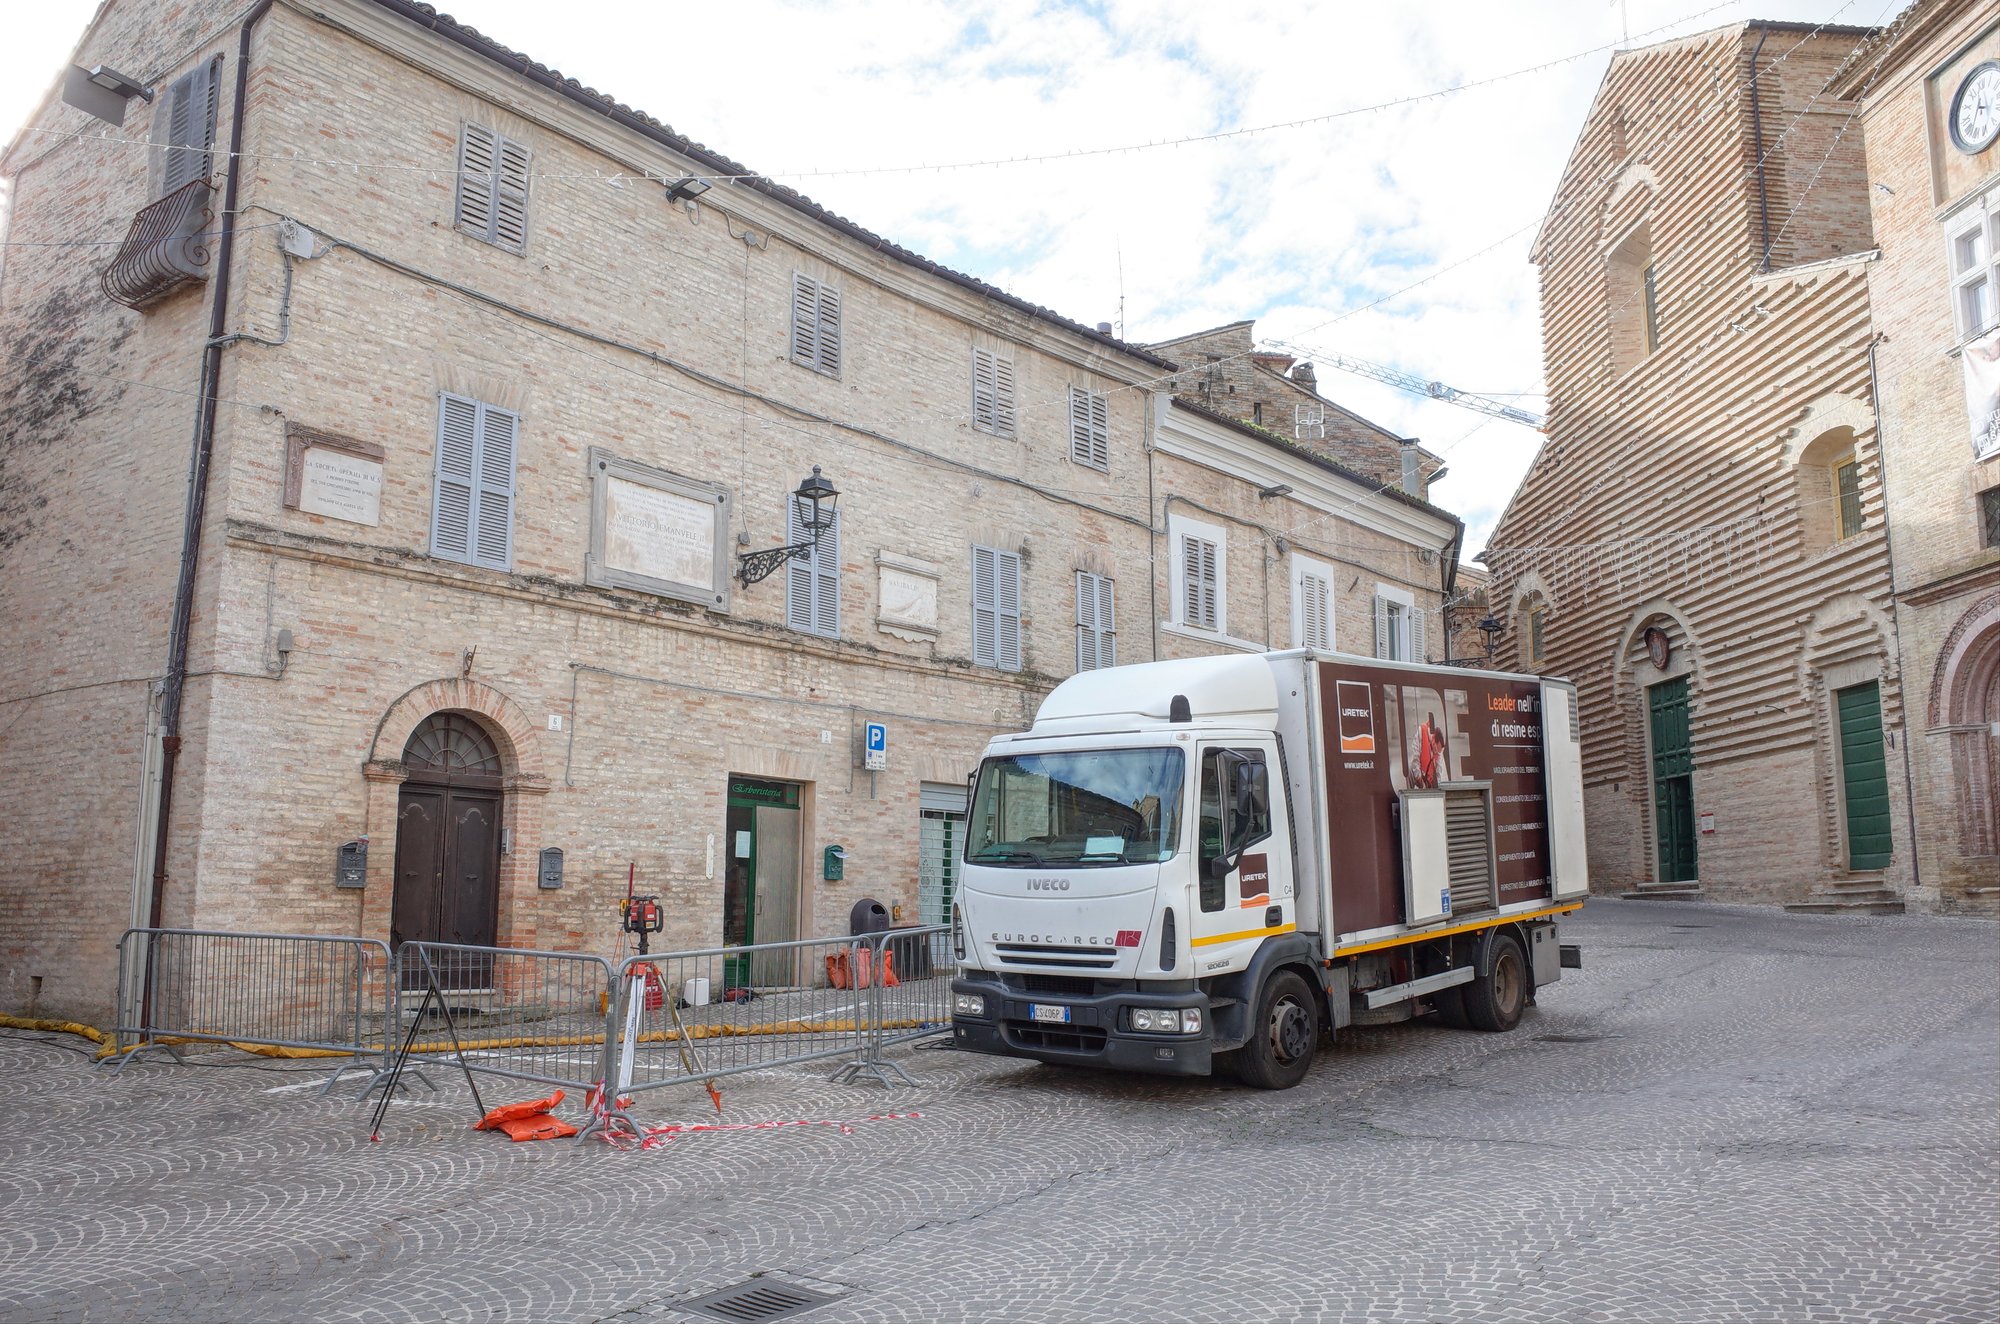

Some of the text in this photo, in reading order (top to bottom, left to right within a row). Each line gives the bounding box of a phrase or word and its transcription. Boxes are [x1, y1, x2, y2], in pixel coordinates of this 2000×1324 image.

[1487, 692, 1516, 712] Leader
[1341, 708, 1369, 718] URETEK
[1491, 718, 1542, 743] di resine esp
[871, 728, 882, 747] P
[1344, 760, 1374, 769] www.uretek.it
[732, 783, 783, 798] Erboristeria
[1241, 872, 1267, 882] URETEK
[1027, 878, 1070, 891] IVECO
[992, 932, 1114, 945] EUROCARGO
